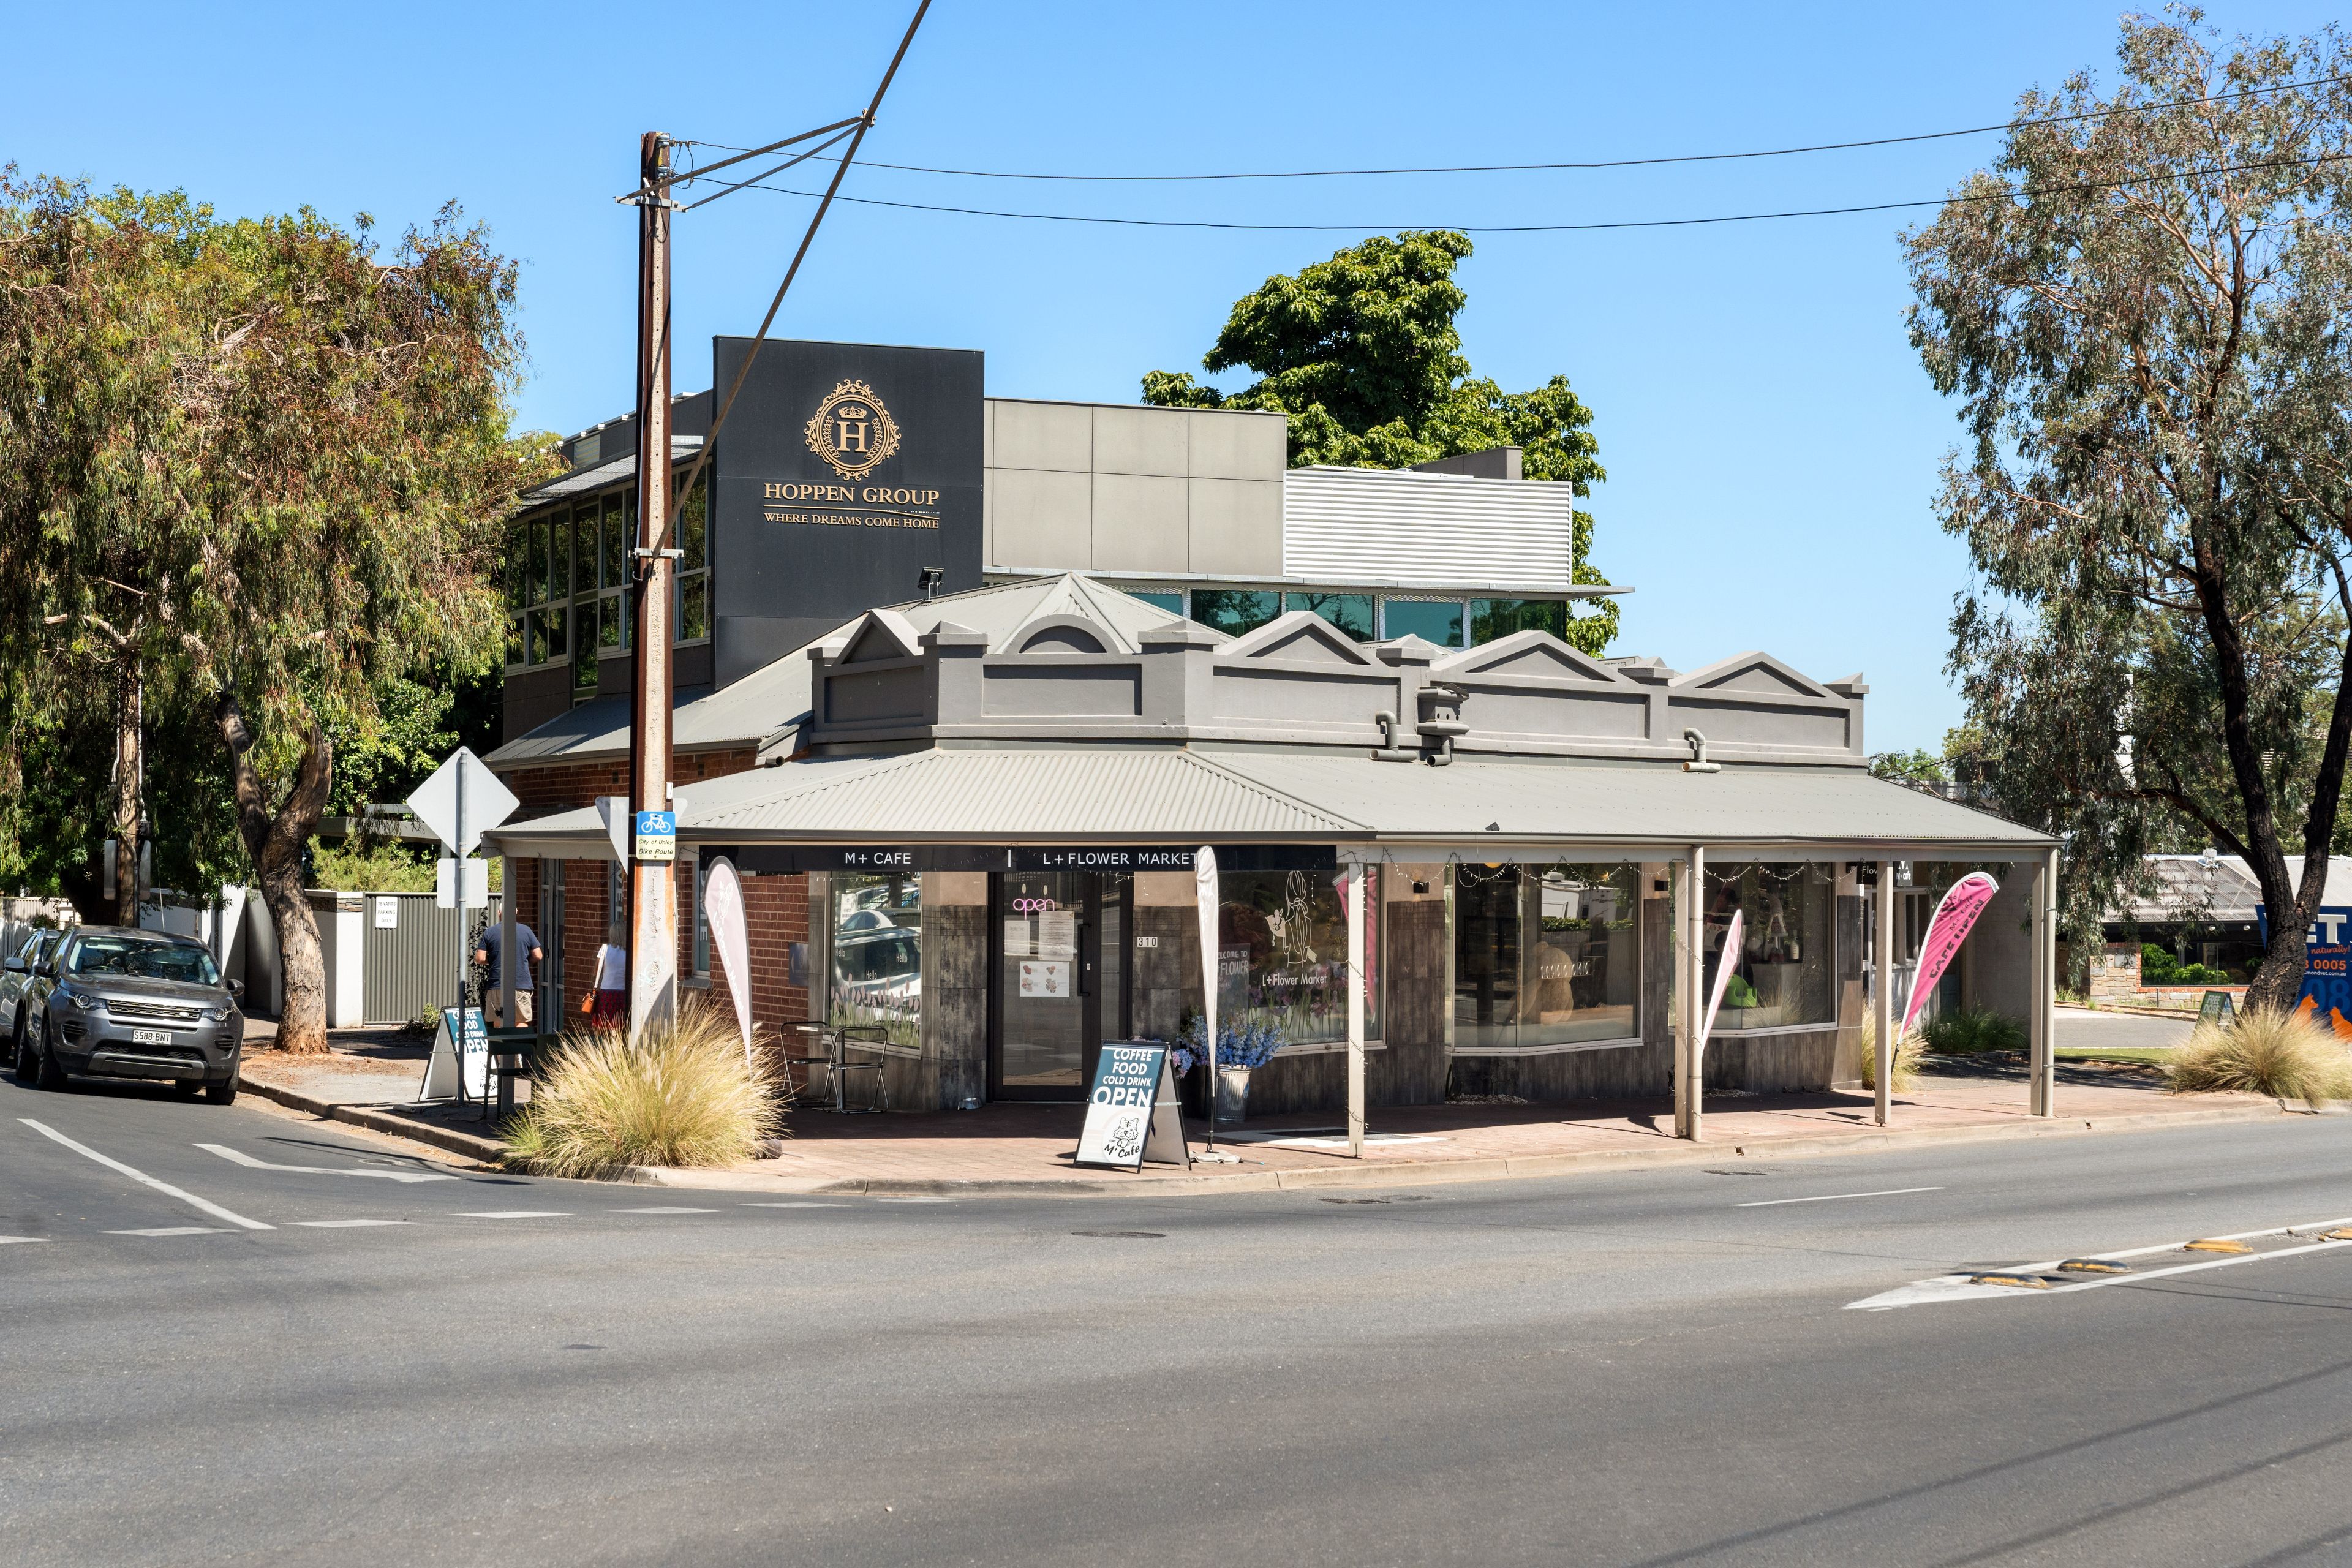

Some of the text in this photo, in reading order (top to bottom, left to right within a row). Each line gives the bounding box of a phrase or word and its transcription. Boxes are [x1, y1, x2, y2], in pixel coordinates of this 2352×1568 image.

[837, 421, 869, 453] H
[764, 483, 940, 505] HOPPEN GROUP
[764, 512, 939, 529] WHERE DREAMS COME HOME
[873, 853, 911, 864] CAFE
[1068, 853, 1129, 865] FLOWER
[1138, 853, 1198, 864] MARKET
[1012, 898, 1055, 921] open
[1139, 937, 1156, 946] 310
[835, 948, 846, 957] Hello
[1218, 951, 1240, 959] ELCOME
[2310, 944, 2351, 954] naturally!
[896, 953, 908, 963] Hello
[1929, 941, 1955, 979] CAFE
[2313, 959, 2347, 970] 0005
[865, 970, 877, 980] Hello
[1300, 971, 1327, 985] Market
[1113, 1049, 1153, 1061] COFFEE
[1112, 1061, 1147, 1076] FOOD
[1102, 1075, 1152, 1087] COLD DRINK
[1093, 1086, 1153, 1107] OPEN
[1118, 1145, 1140, 1158] Cafe
